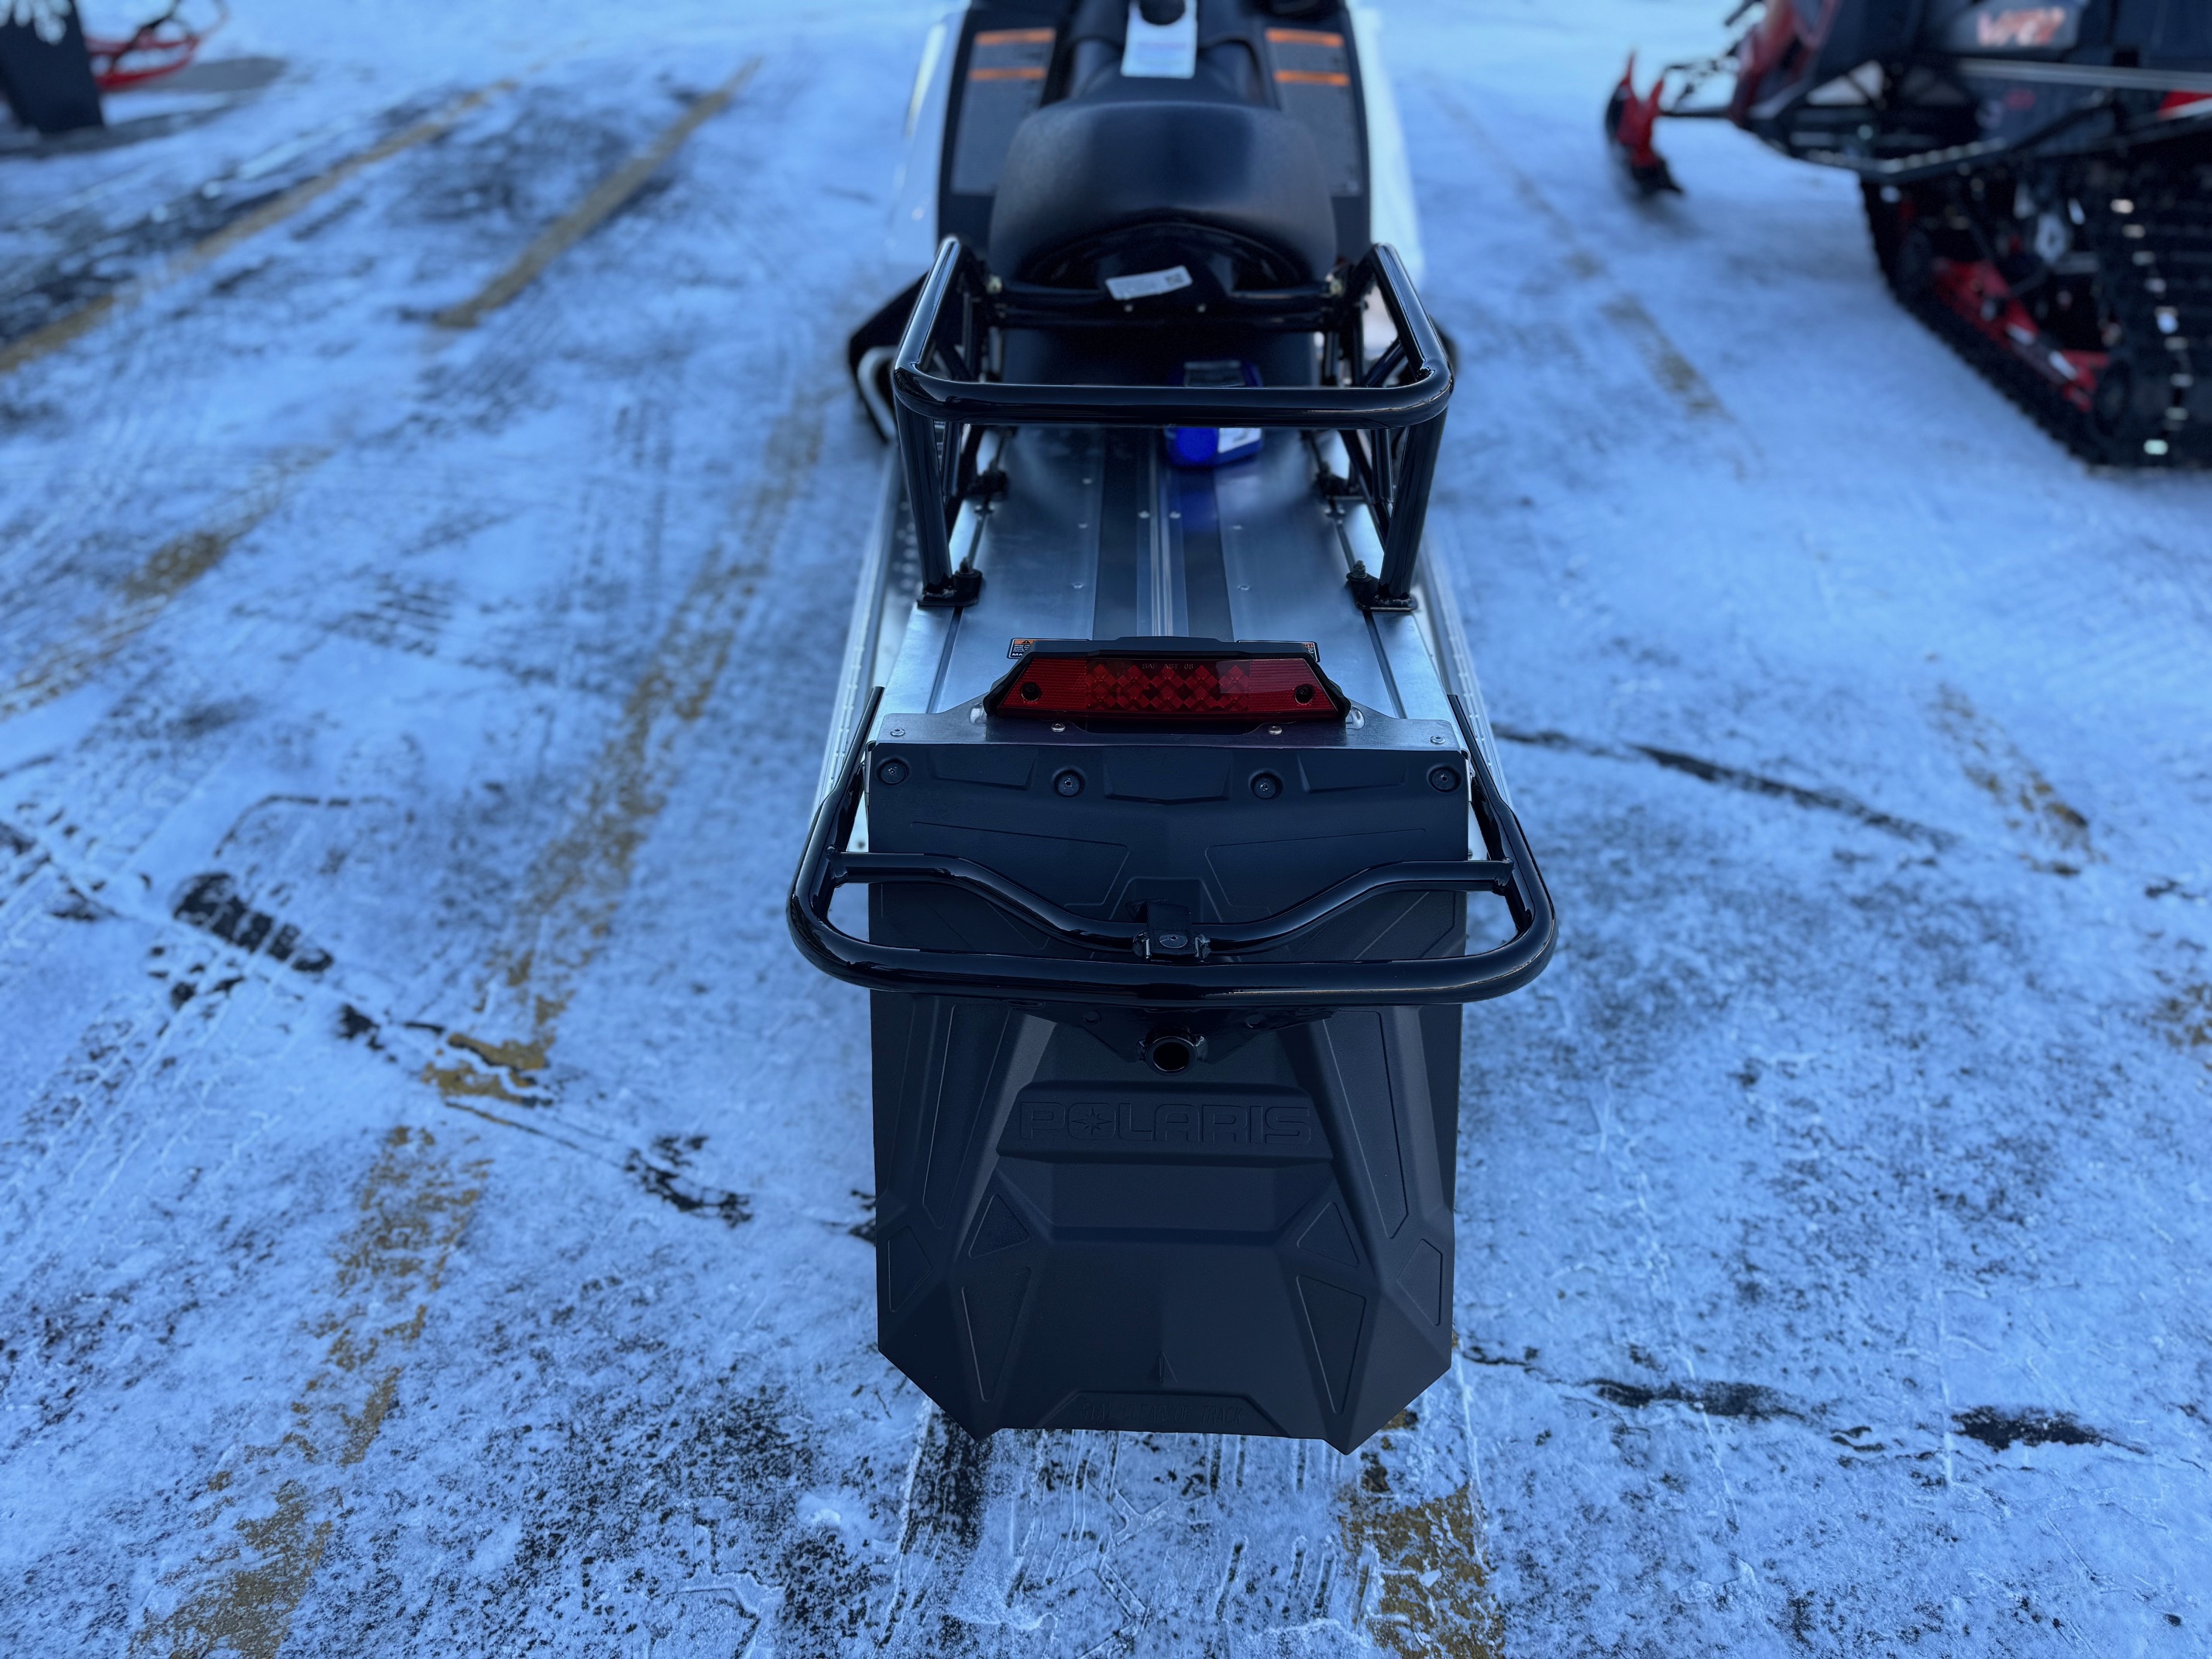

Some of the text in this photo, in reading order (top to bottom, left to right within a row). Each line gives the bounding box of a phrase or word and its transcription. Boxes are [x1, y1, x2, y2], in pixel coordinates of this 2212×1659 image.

[1019, 1101, 1311, 1145] POLARIS
[1081, 1402, 1245, 1426] STAY CLEAR OF TRACK
